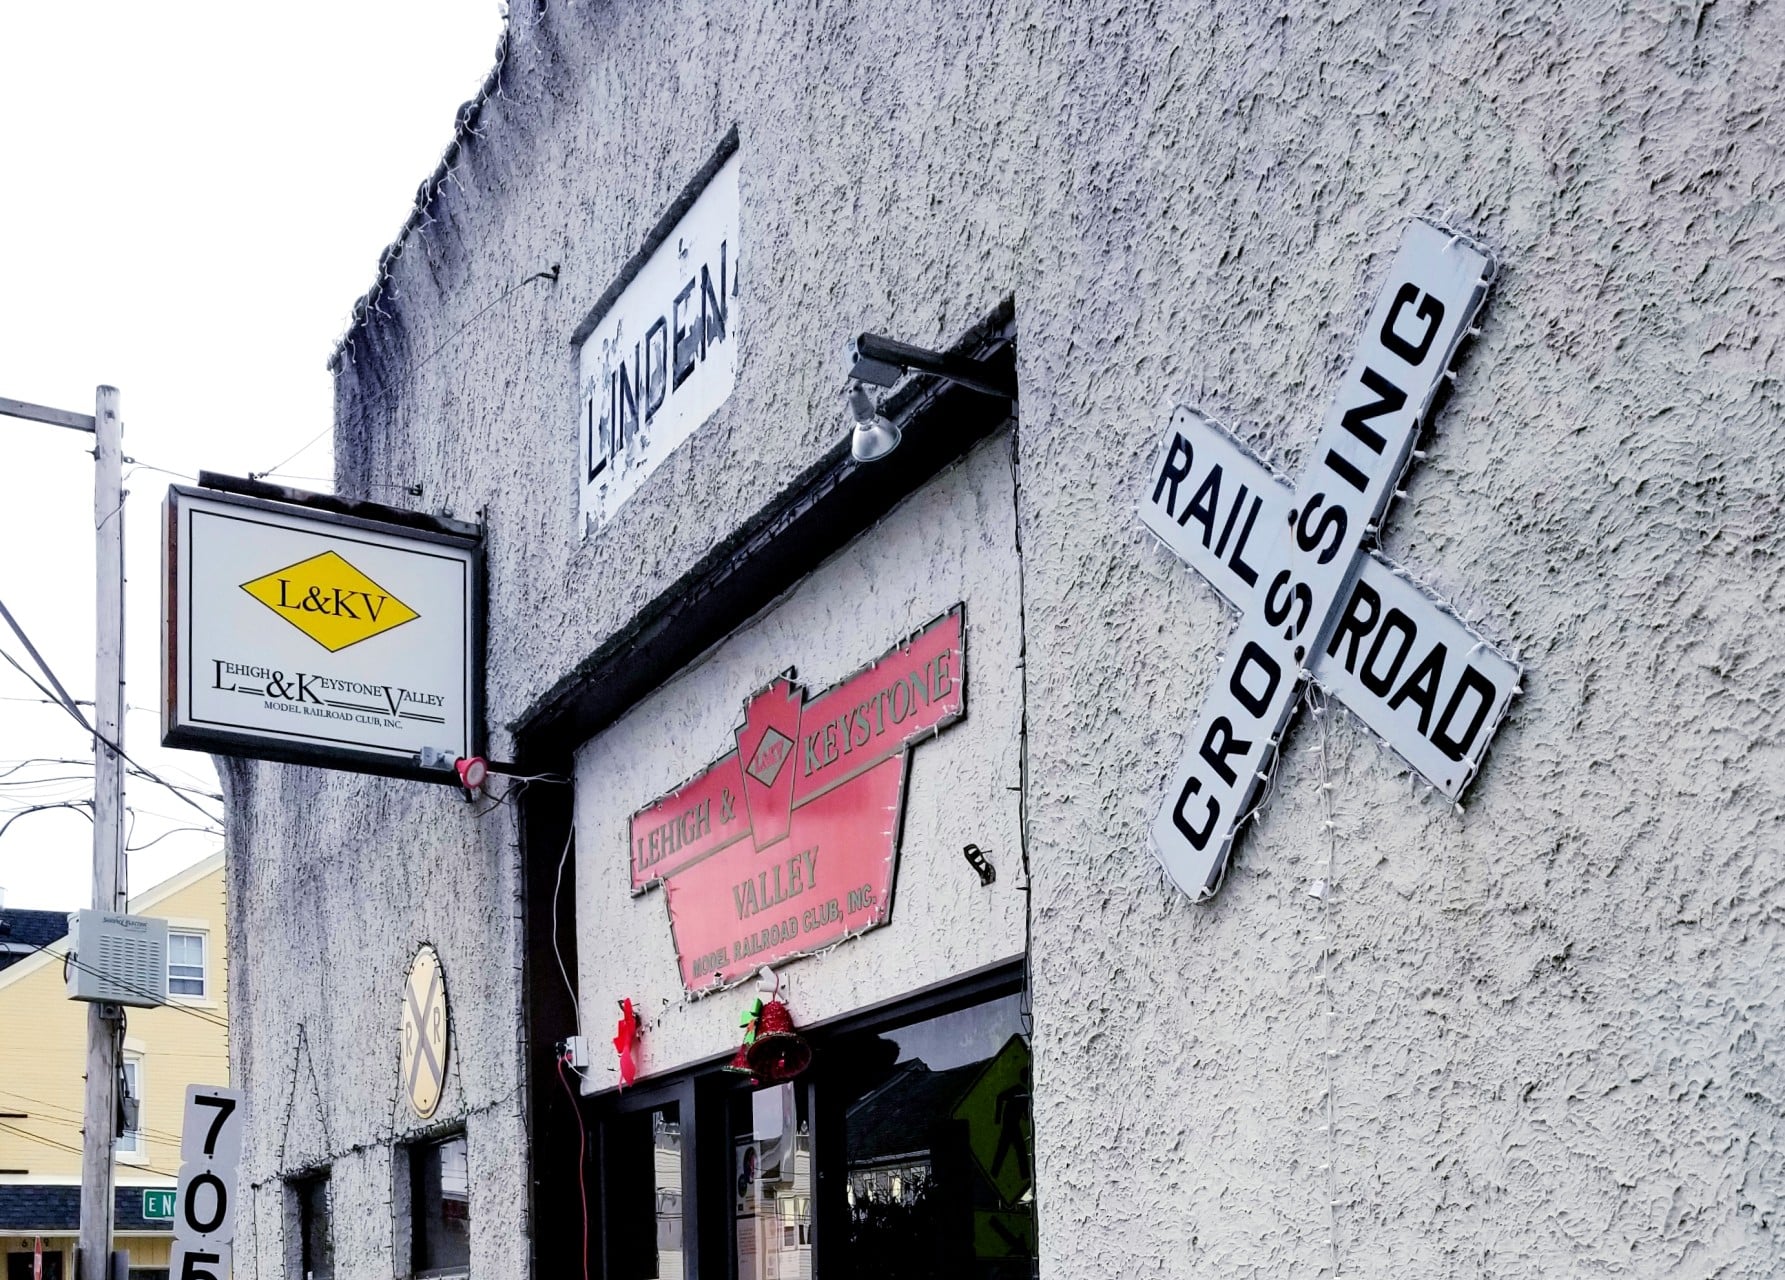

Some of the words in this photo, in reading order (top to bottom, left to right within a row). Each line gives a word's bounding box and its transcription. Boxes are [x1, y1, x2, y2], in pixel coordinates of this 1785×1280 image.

[587, 238, 728, 485] LINDEN
[276, 578, 388, 623] L&KV
[1152, 430, 1264, 589] RAIL
[1326, 578, 1498, 763] ROAD
[1173, 281, 1445, 852] CROSSING
[264, 700, 301, 714] MODEL
[303, 706, 353, 721] RAILROAD
[355, 715, 382, 728] CLUB,
[384, 718, 403, 730] INC.
[266, 670, 295, 700] &
[637, 797, 712, 873] LEHIGH
[719, 786, 736, 825] &
[803, 649, 952, 778] KEYSTONE
[732, 845, 819, 921] VALLEY
[692, 947, 730, 979] MODEL
[733, 915, 799, 962] RAILROAD
[802, 899, 844, 934] CLUB,
[846, 884, 877, 915] INC.
[149, 1197, 157, 1212] E
[162, 1194, 177, 1216] N
